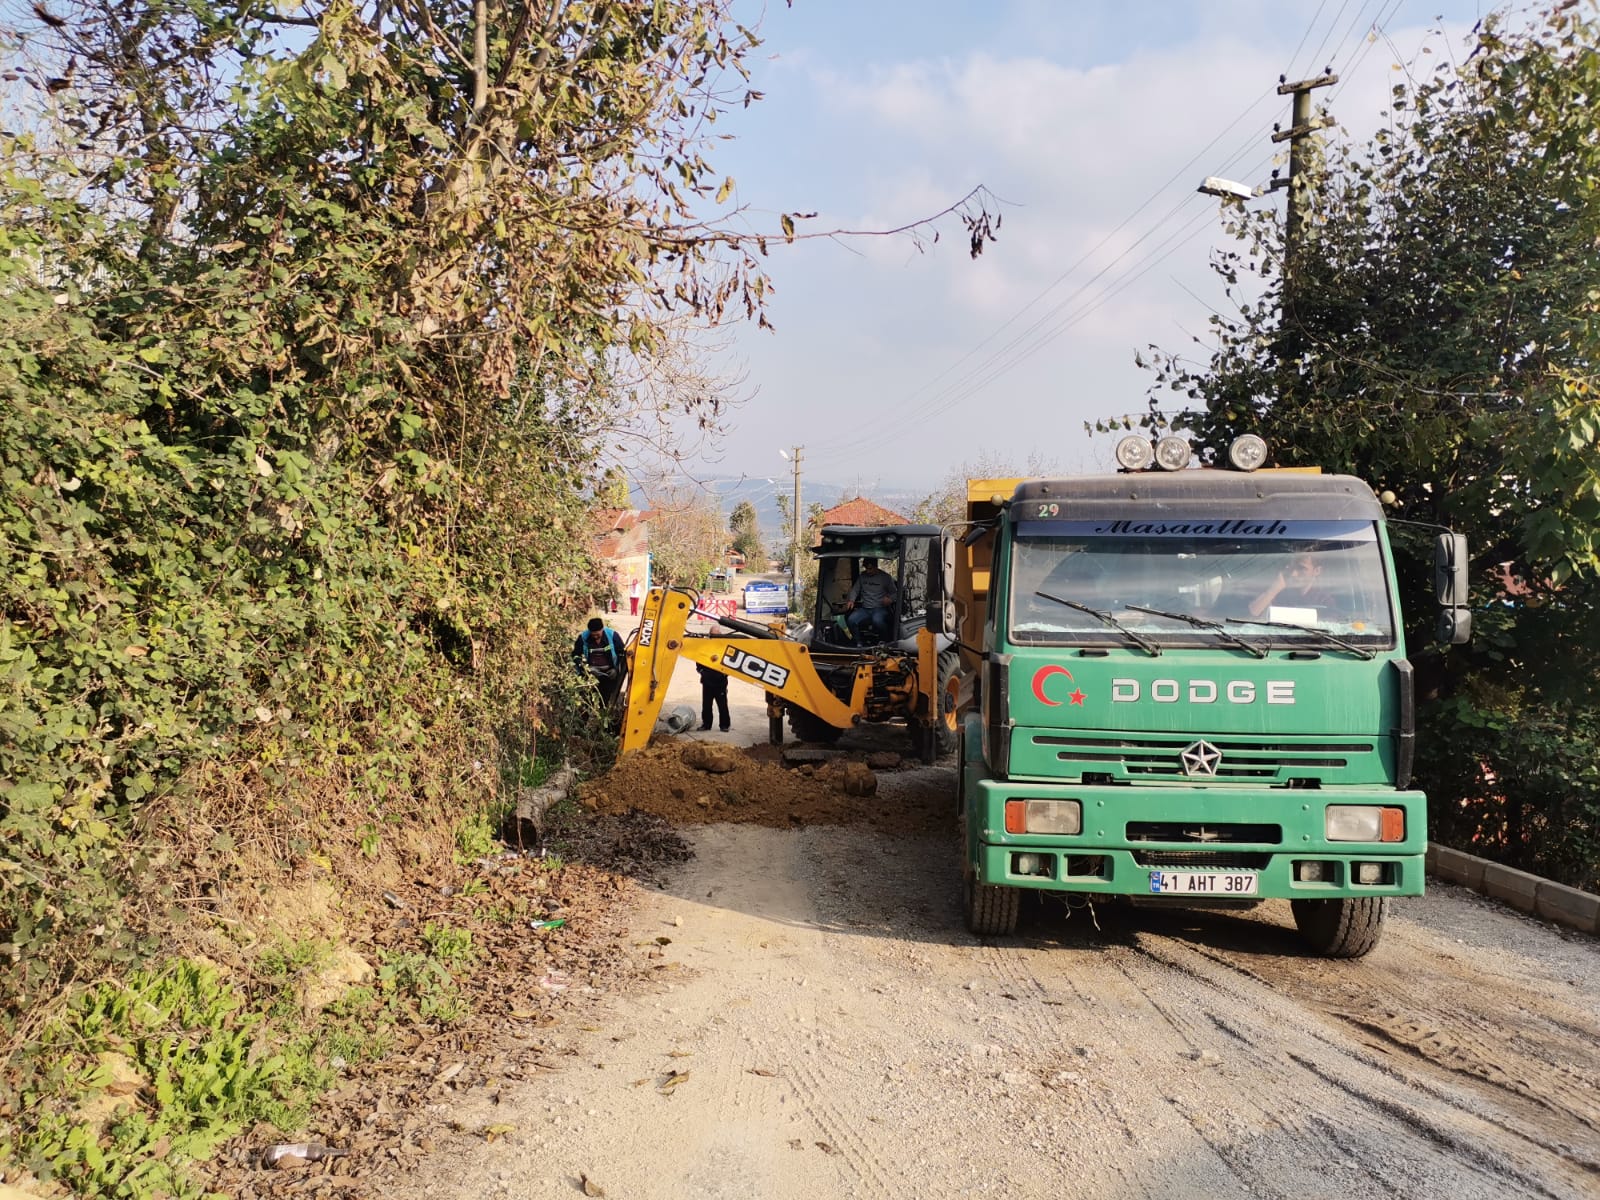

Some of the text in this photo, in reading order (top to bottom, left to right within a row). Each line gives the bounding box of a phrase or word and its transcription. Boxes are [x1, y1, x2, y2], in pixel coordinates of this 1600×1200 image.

[1038, 503, 1060, 518] 29
[722, 651, 788, 688] JCB
[1112, 678, 1296, 705] DODGE
[1161, 874, 1254, 892] 41 AHT 387
